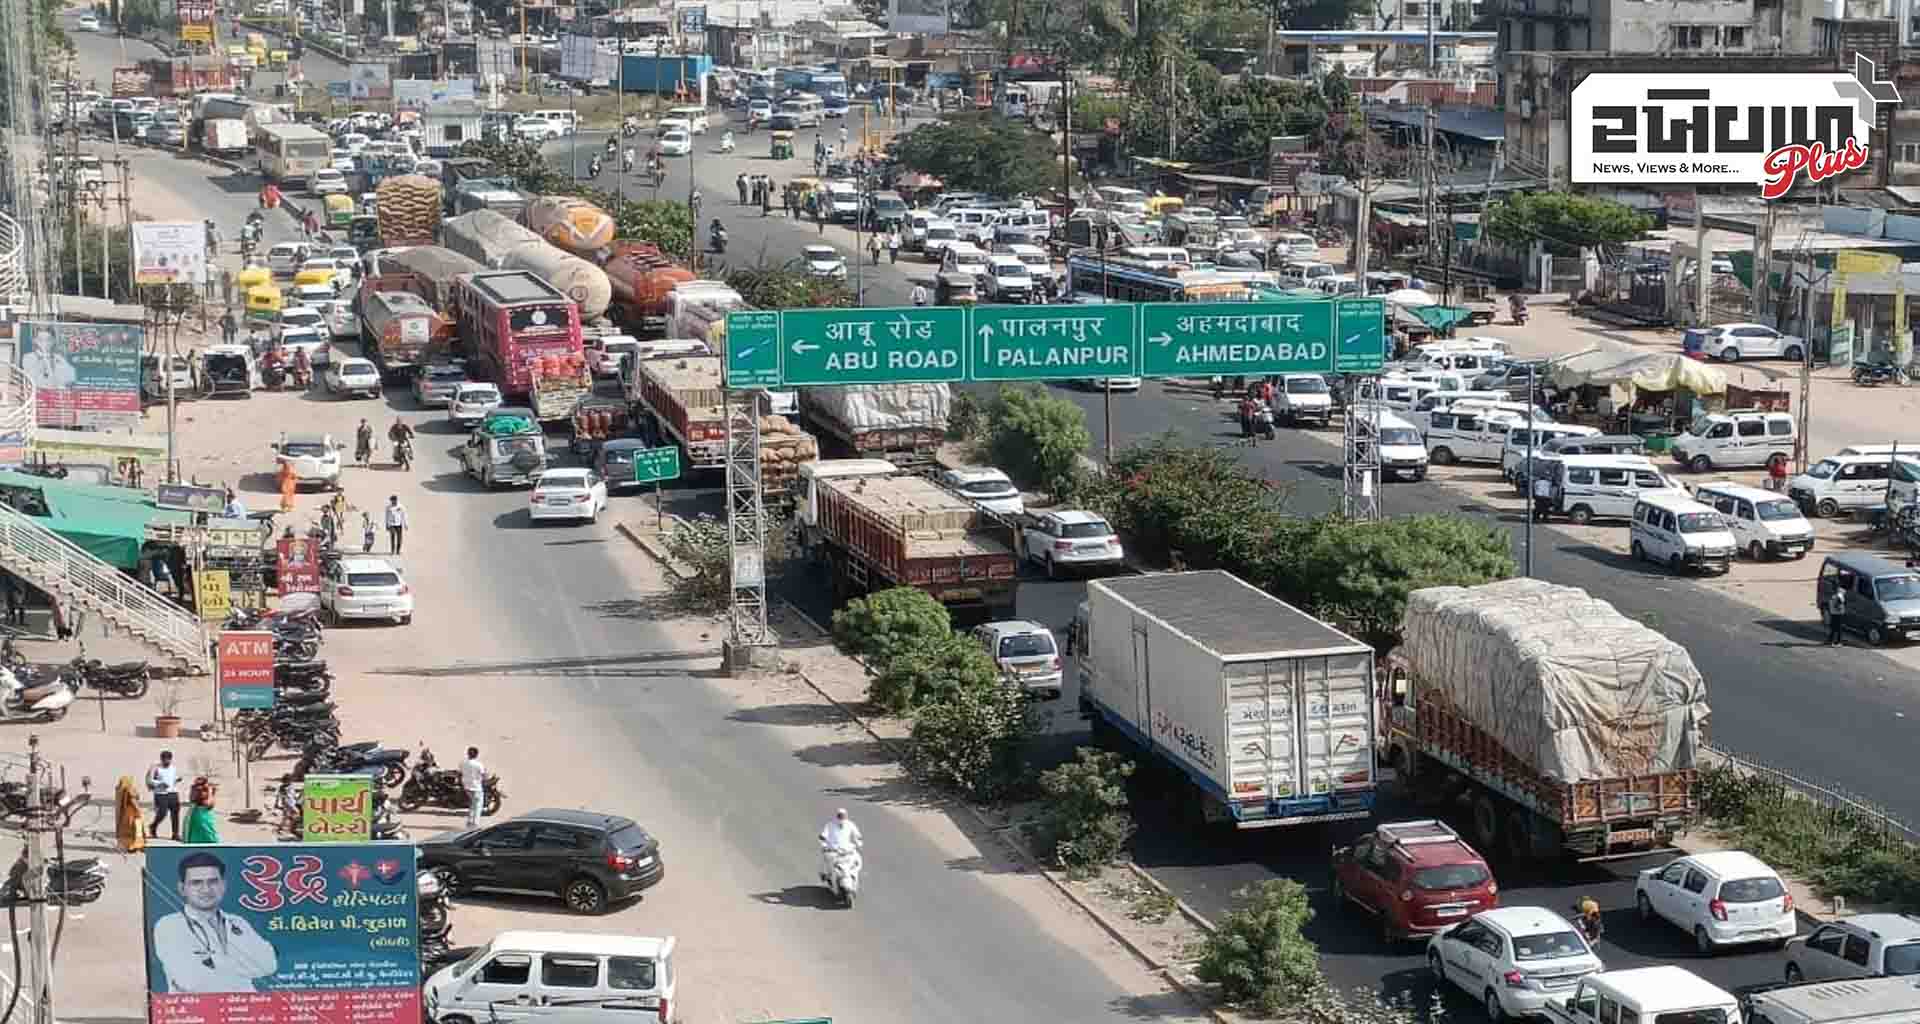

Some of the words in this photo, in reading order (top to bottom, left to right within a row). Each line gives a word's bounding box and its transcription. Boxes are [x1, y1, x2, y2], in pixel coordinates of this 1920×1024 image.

[825, 319, 877, 347] आबू
[886, 313, 936, 341] रोड
[1000, 316, 1105, 343] पालनपुर
[1176, 313, 1304, 335] अहमदाबाद
[825, 352, 878, 371] ABU
[888, 349, 958, 369] ROAD
[998, 345, 1129, 367] PALANPUR
[1175, 342, 1326, 364] AHMEDABAD
[226, 641, 269, 656] ATM
[238, 669, 271, 678] HOUR
